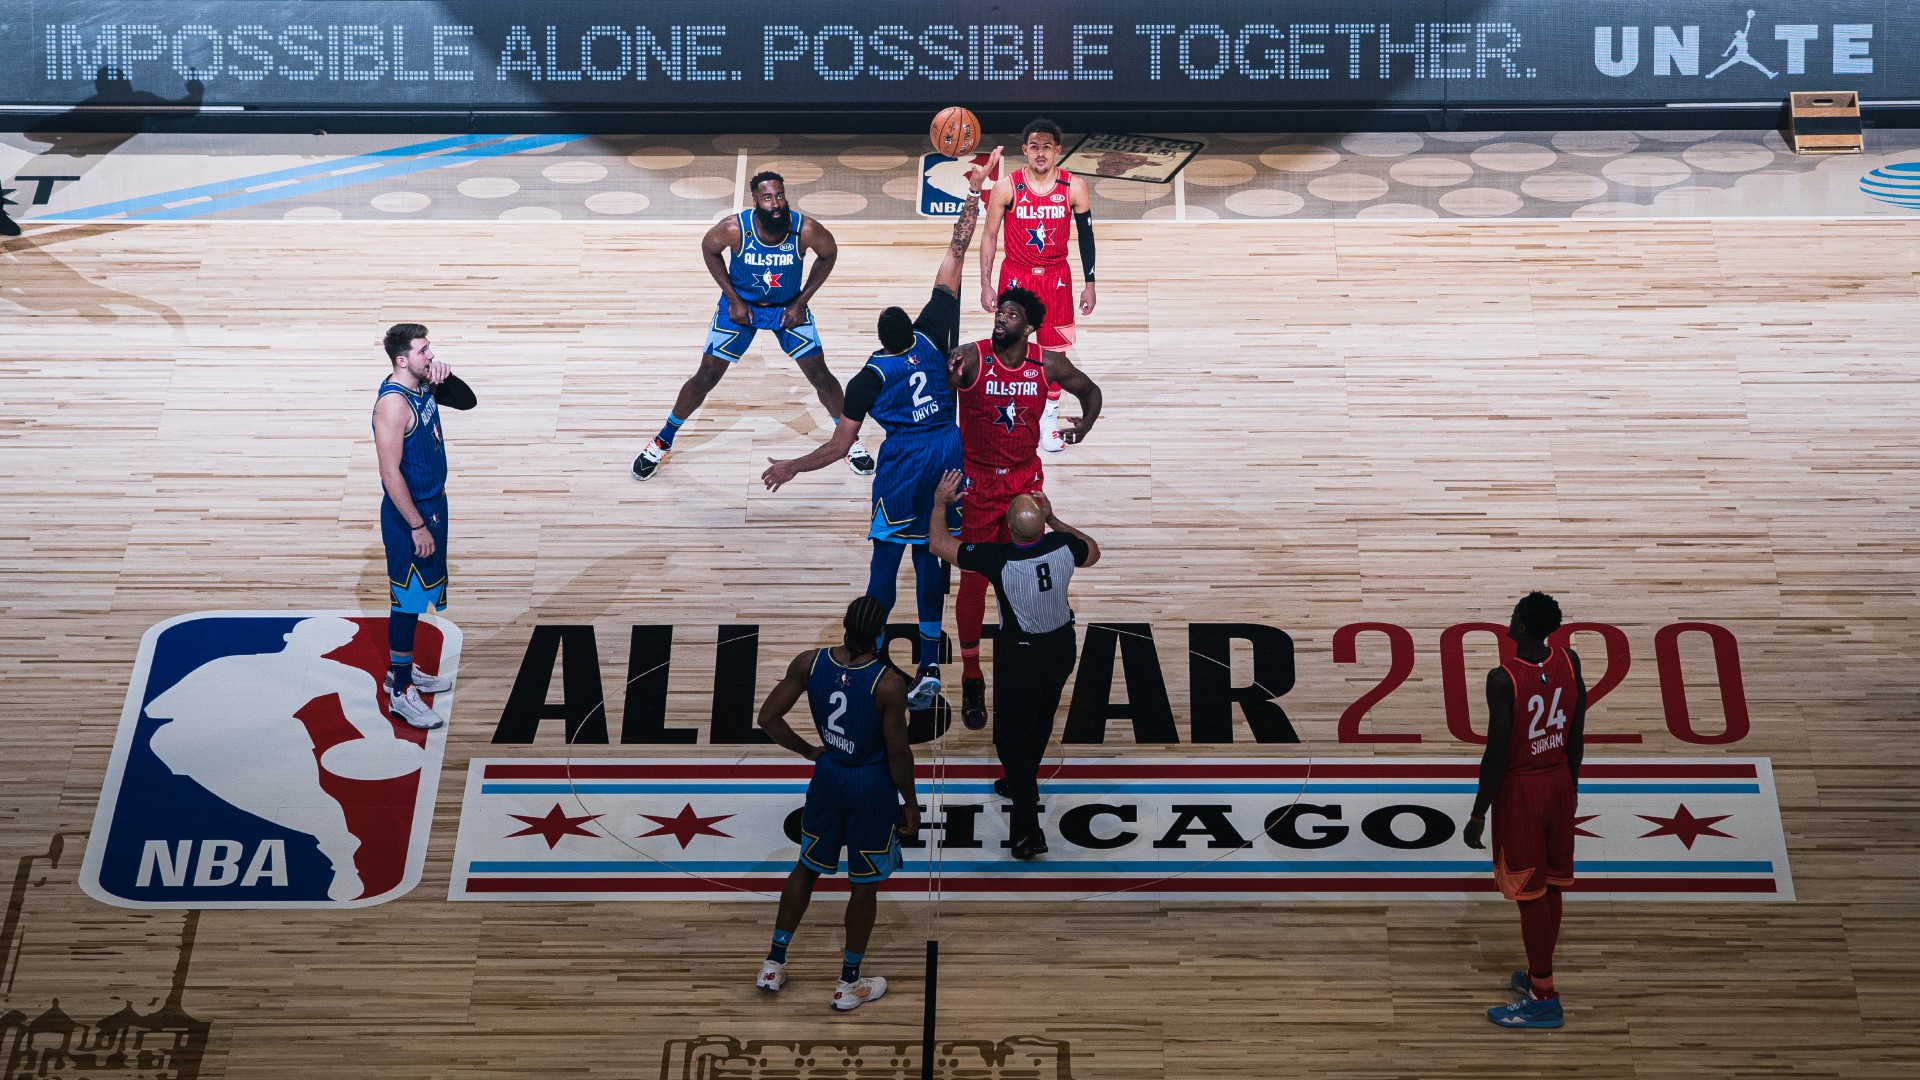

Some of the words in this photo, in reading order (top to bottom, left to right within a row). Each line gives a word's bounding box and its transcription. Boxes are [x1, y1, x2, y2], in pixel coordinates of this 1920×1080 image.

[46, 25, 474, 81] IMPOSSIBLE
[497, 25, 742, 81] ALONE.
[764, 24, 1113, 80] POSSIBLE
[1135, 23, 1537, 80] TOGETHER.
[1016, 205, 1066, 219] ALL-STAR
[744, 253, 794, 266] ALL-STAR
[909, 371, 933, 407] 2
[985, 381, 1038, 395] ALL-STAR
[912, 400, 939, 422] DAVIS
[1036, 562, 1052, 592] 8
[828, 691, 848, 735] 2
[1528, 687, 1566, 740] 24
[822, 726, 855, 755] LEONARD
[1531, 732, 1563, 756] SIAKAM
[135, 839, 289, 887] NBA
